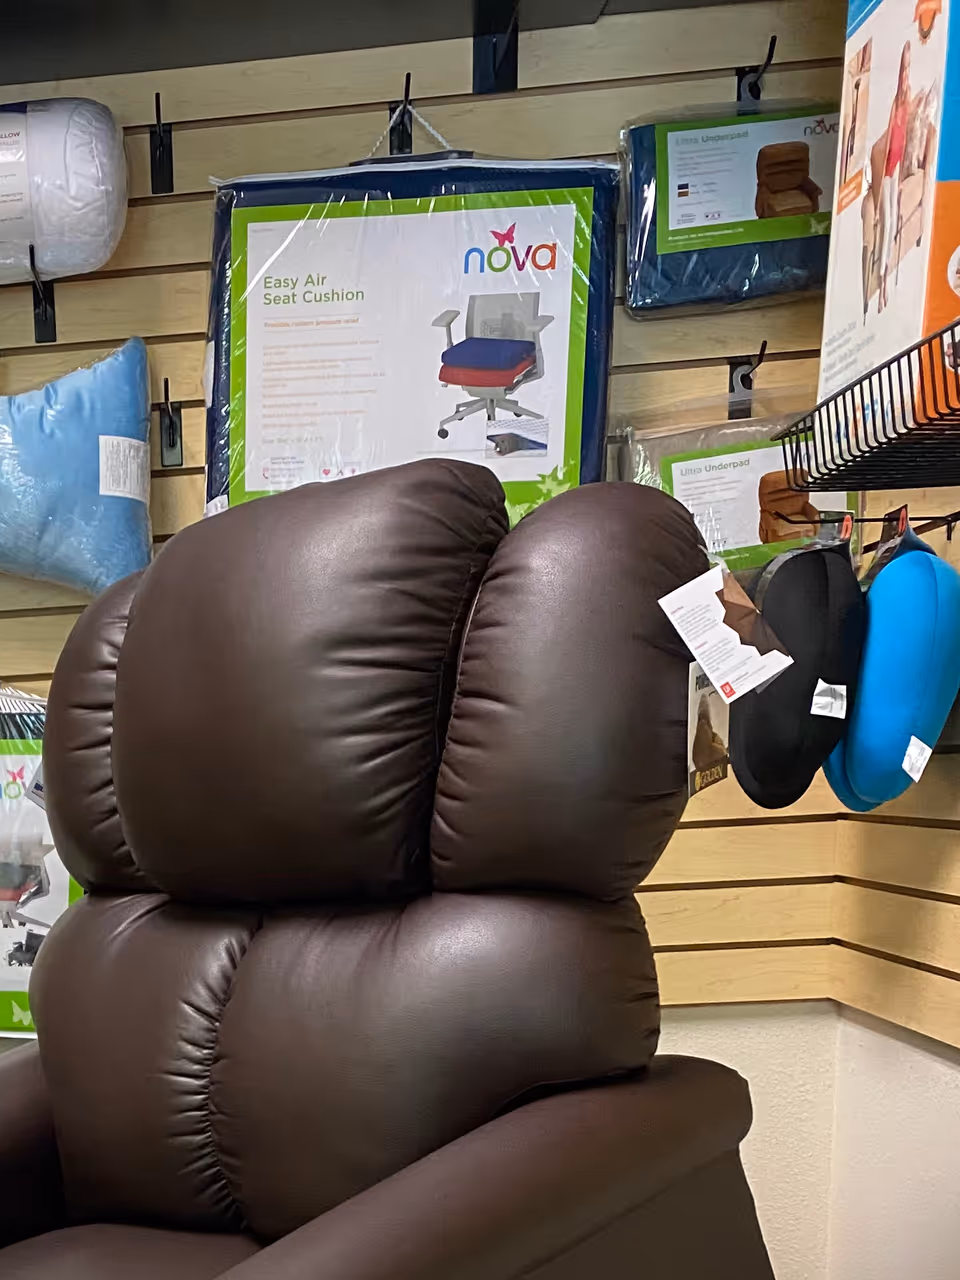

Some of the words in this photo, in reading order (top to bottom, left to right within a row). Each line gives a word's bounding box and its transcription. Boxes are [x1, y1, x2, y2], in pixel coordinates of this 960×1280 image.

[675, 136, 698, 146] Ultra
[701, 130, 749, 143] Underpad
[463, 242, 557, 275] nova
[263, 276, 299, 290] Easy
[304, 273, 327, 287] Air
[263, 291, 297, 305] Seat
[302, 288, 365, 303] Cushion
[680, 467, 702, 477] Ultra
[704, 458, 750, 473] Underpad
